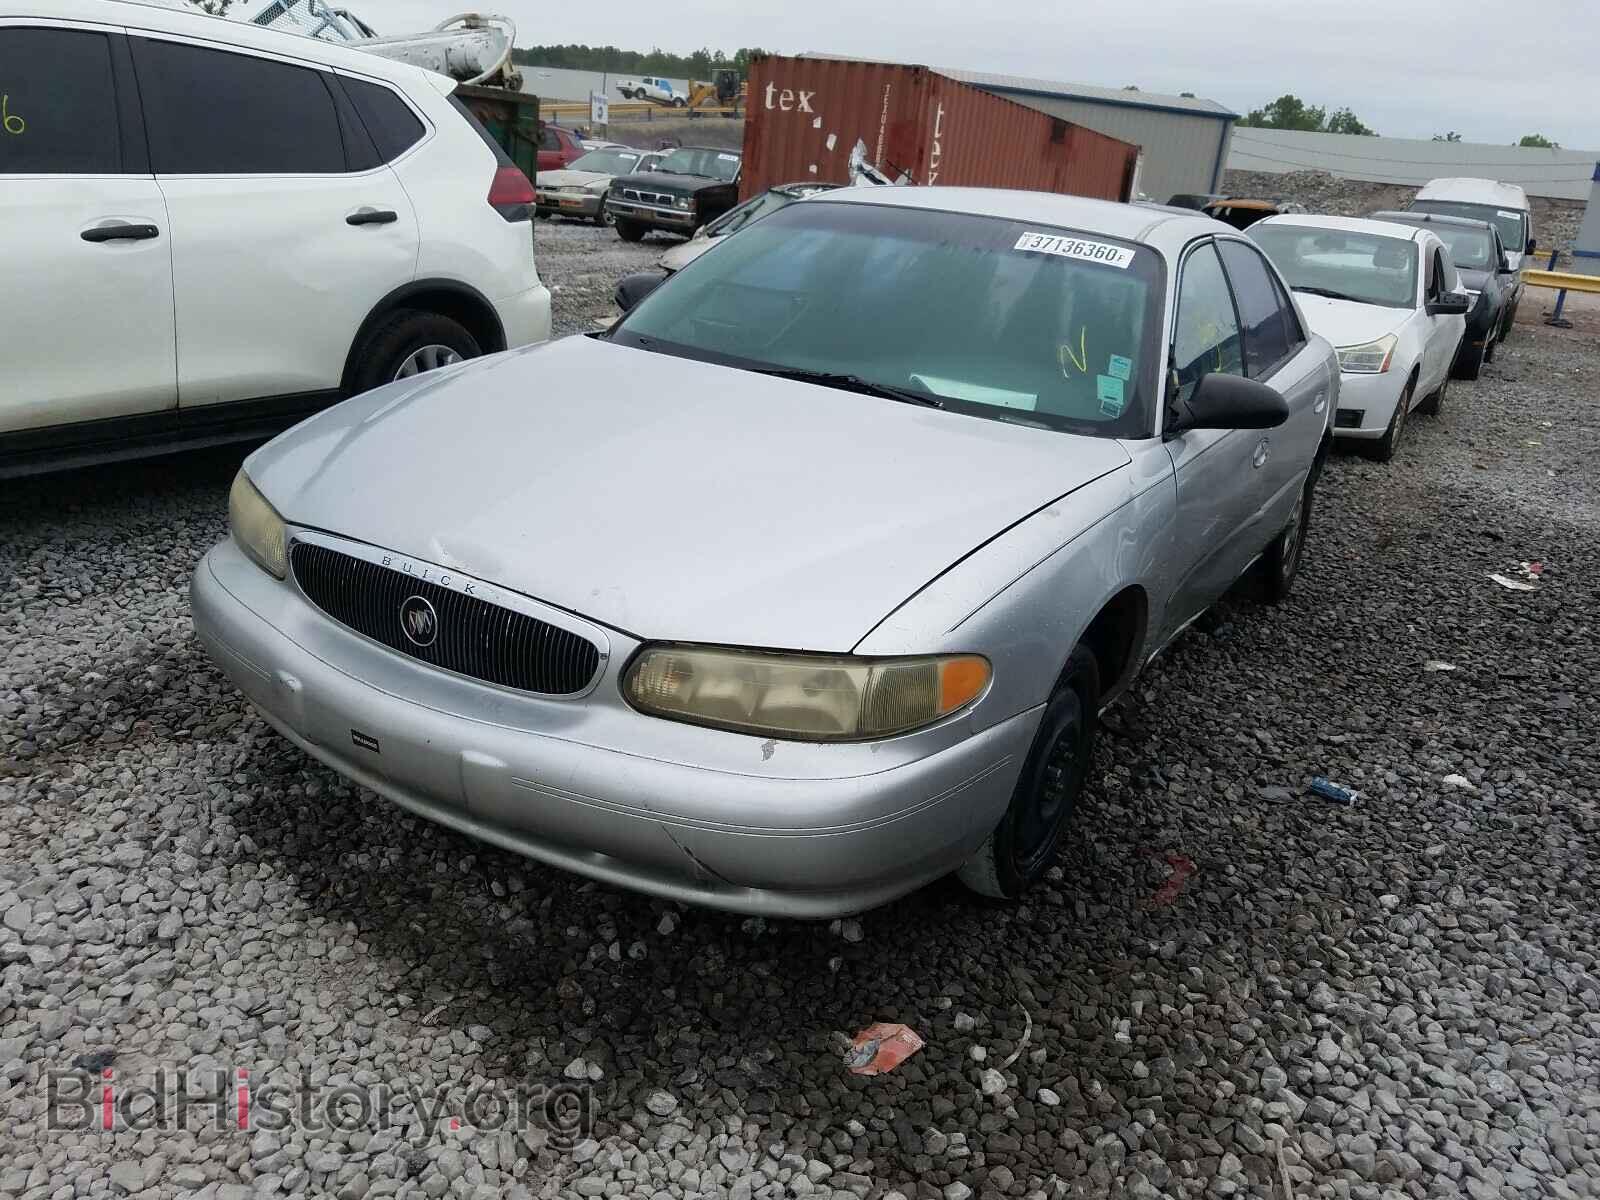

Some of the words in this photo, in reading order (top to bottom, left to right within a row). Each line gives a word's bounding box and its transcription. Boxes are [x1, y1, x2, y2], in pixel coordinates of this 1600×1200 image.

[765, 81, 816, 113] tex
[1030, 235, 1118, 261] 37136360
[382, 555, 476, 595] BUICK
